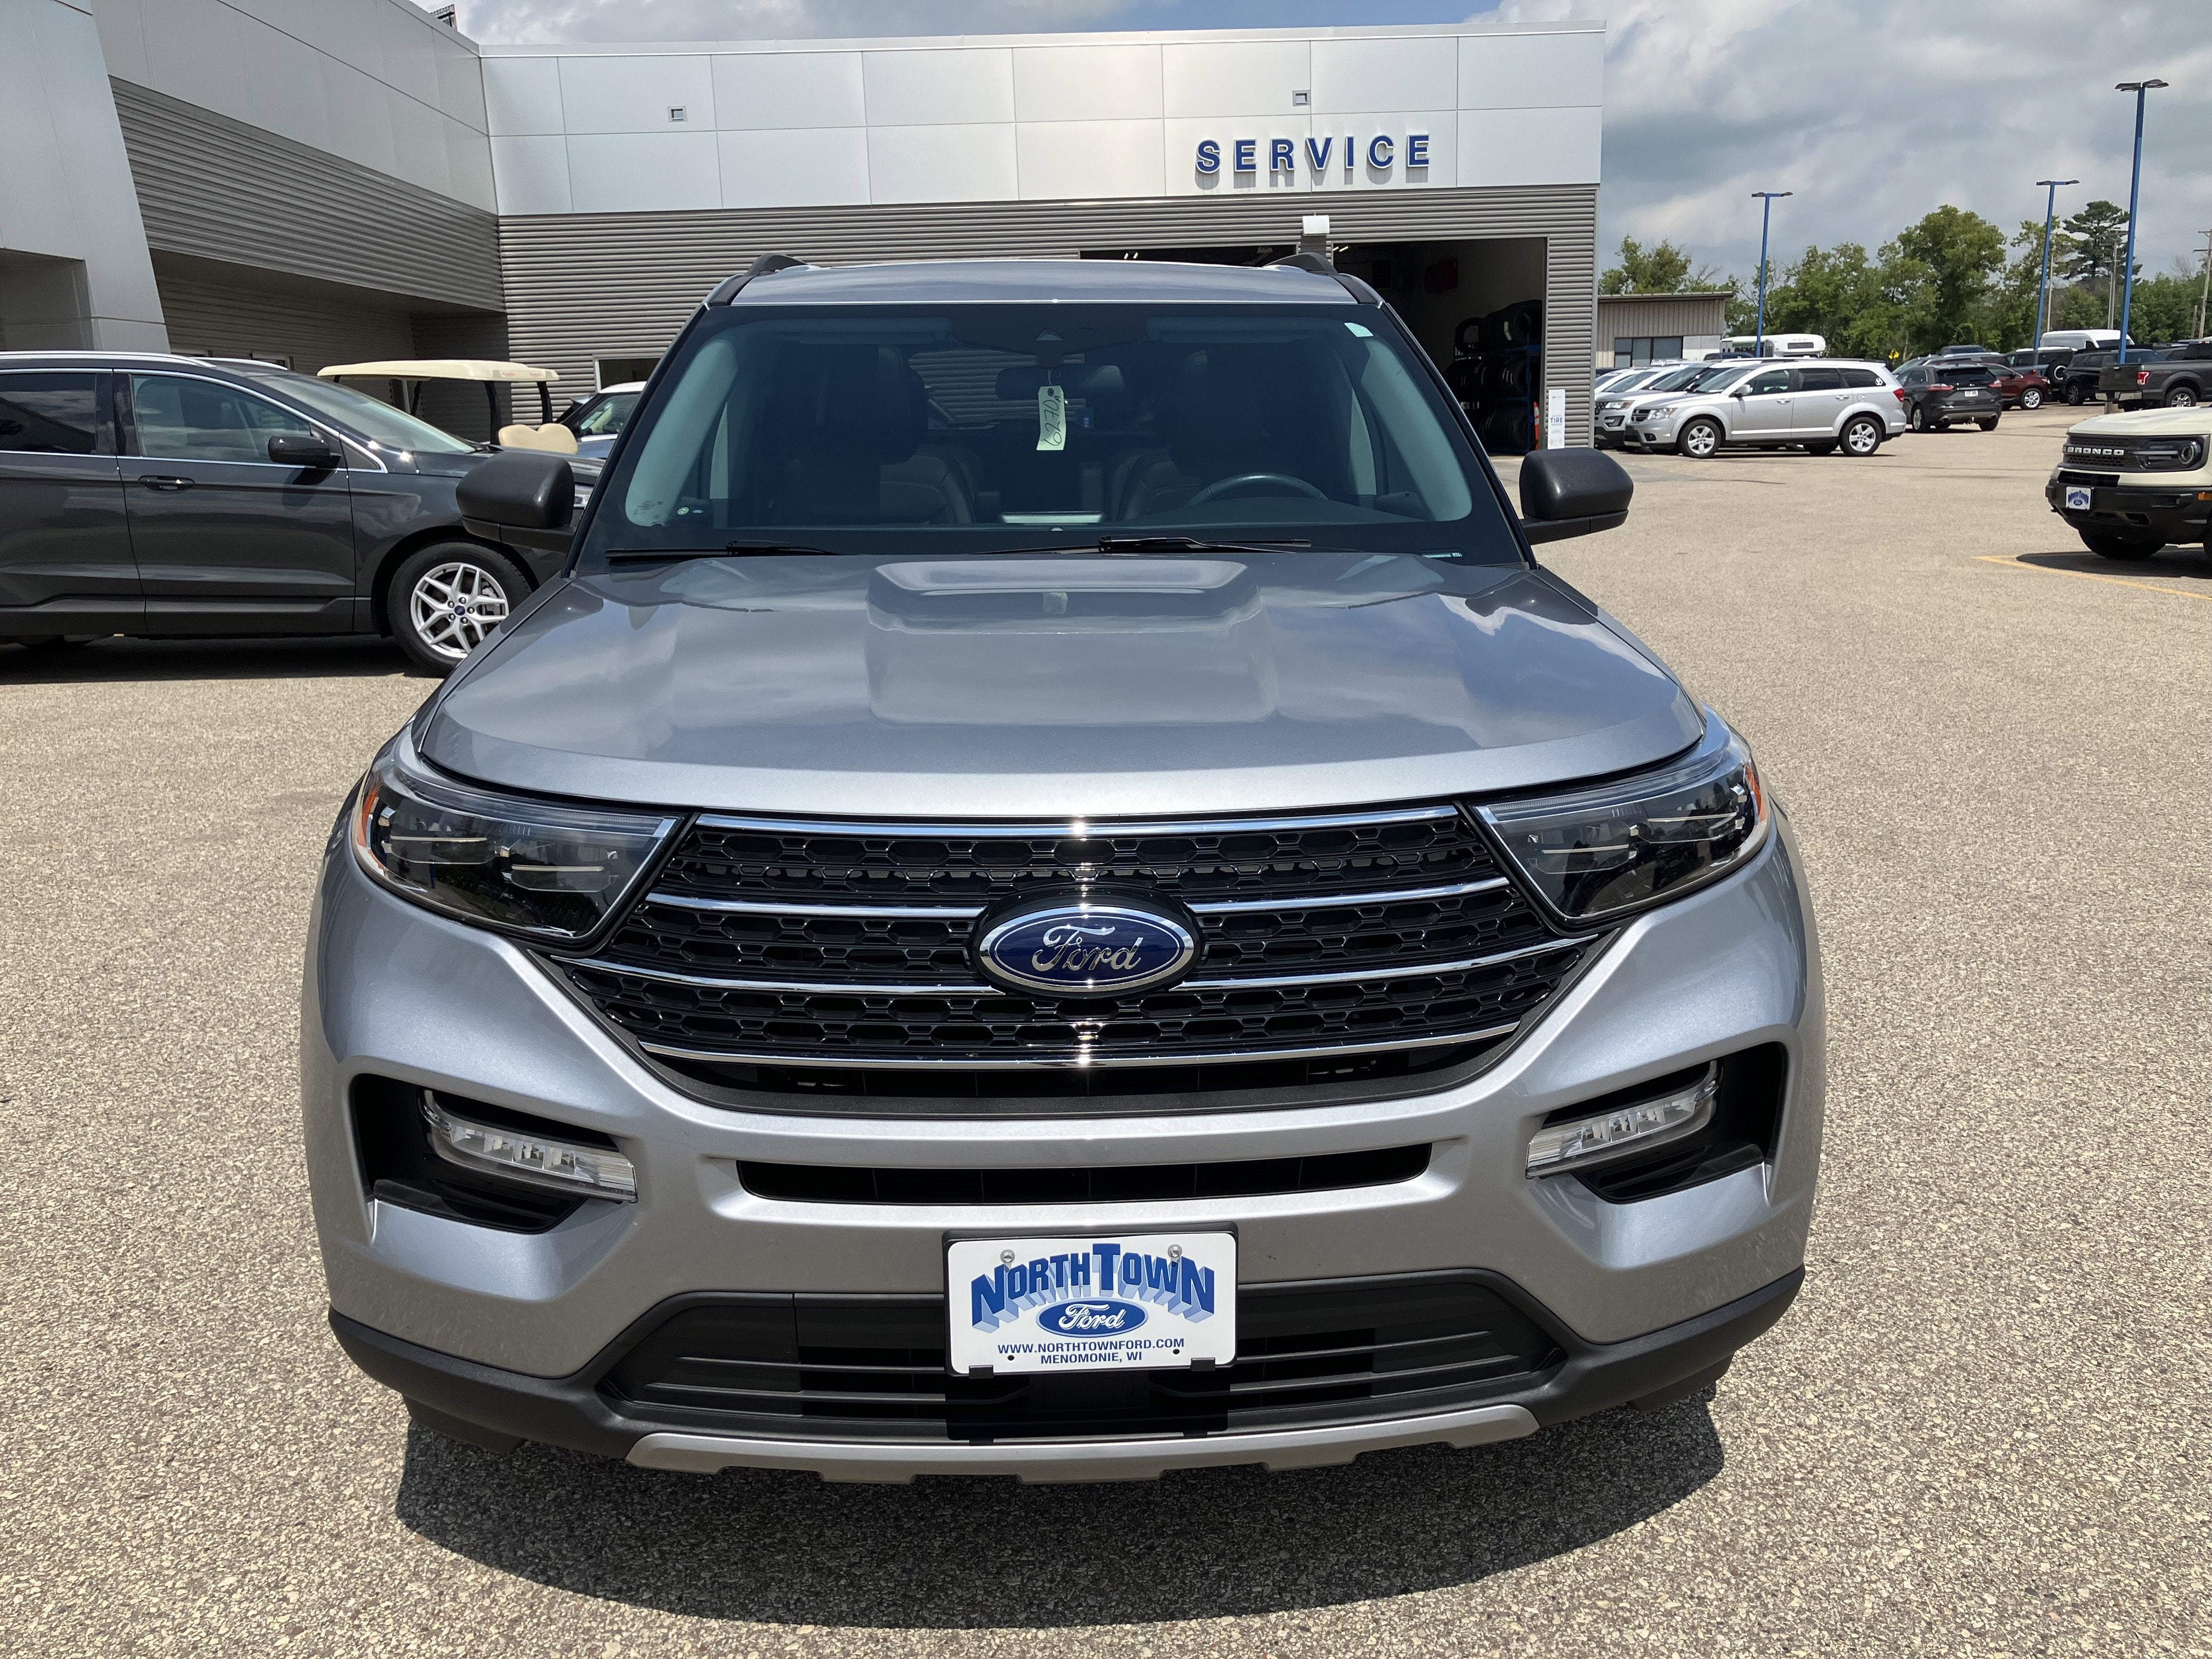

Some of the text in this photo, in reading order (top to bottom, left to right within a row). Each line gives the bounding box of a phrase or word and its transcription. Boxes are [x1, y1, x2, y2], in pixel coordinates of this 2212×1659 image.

[1195, 134, 1431, 174] SERVICE
[2067, 447, 2124, 455] BRONCO
[1032, 924, 1143, 971] Ford
[1058, 1303, 1125, 1330] Ford
[997, 1338, 1184, 1354] WWW.NORTHTOWNFORD.COM
[1040, 1352, 1143, 1364] MENOMONIE, WI
